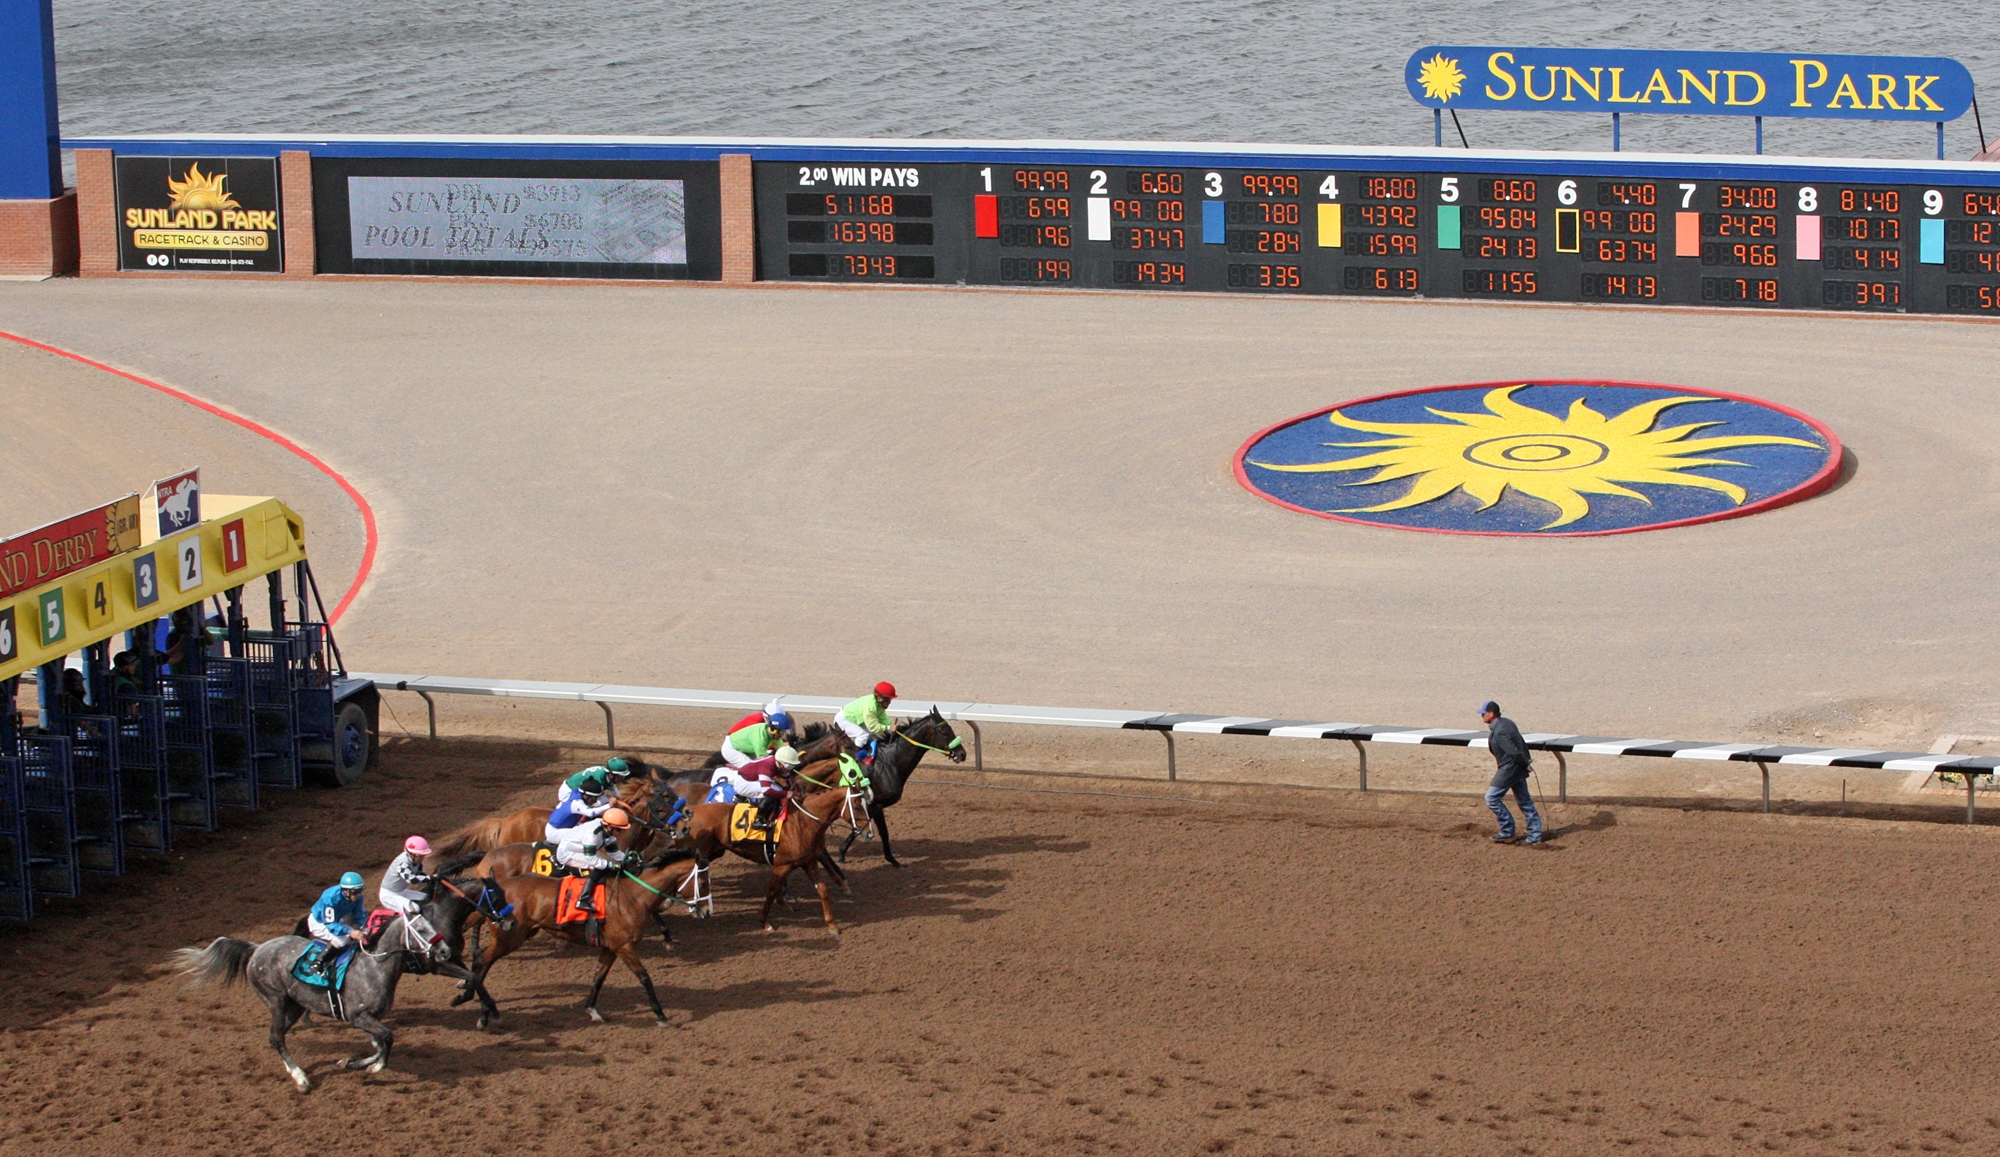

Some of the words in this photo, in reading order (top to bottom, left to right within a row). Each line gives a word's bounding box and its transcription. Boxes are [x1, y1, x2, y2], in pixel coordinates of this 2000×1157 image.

[1485, 52, 1767, 106] SUNLAND
[1790, 59, 1944, 111] PARK
[830, 167, 866, 187] WIN
[872, 167, 920, 188] PAYS
[980, 167, 993, 192] 1
[1015, 170, 1069, 191] 99.99
[1089, 169, 1108, 195] 2
[1141, 172, 1183, 194] 6.60
[1204, 172, 1223, 198] 3
[1243, 174, 1299, 197] 99.99
[1319, 175, 1339, 200] 4
[1367, 177, 1416, 200] 18.80
[1440, 177, 1460, 203] 5
[1493, 180, 1536, 202] 8.60
[1557, 179, 1578, 206] 6
[1612, 183, 1656, 207] 4.40
[1678, 183, 1697, 209] 7
[1721, 186, 1777, 209] 34.00
[1797, 186, 1818, 212] 8
[1840, 189, 1899, 213] 81.40
[387, 191, 521, 214] SUNLAND
[825, 194, 894, 216] 51168
[1028, 197, 1070, 218] 699
[1258, 202, 1299, 225] 780
[1923, 189, 1944, 216] 9
[126, 208, 218, 230] SUNLAND
[221, 210, 278, 230] PARK
[1361, 205, 1417, 227] 4392
[1480, 207, 1537, 230] 9584
[1719, 214, 1777, 237] 2429
[139, 233, 210, 245] RACETRACK
[212, 235, 220, 245] &
[222, 235, 265, 246] CASINO
[363, 225, 436, 248] POOL
[833, 221, 895, 243] 16398
[1036, 226, 1070, 247] 196
[1131, 228, 1184, 249] 3747
[1849, 218, 1899, 240] 1017
[1973, 221, 2000, 244] 12
[1257, 231, 1300, 253] 284
[1369, 233, 1417, 255] 1599
[1480, 236, 1537, 259] 2413
[1599, 239, 1657, 262] 6374
[844, 255, 896, 277] 7343
[1733, 243, 1777, 267] 966
[1855, 249, 1900, 269] 414
[1036, 260, 1071, 281] 199
[1138, 262, 1185, 283] 1934
[1260, 265, 1300, 288] 335
[1375, 268, 1418, 290] 613
[1488, 271, 1537, 294] 1155
[1607, 276, 1657, 298] 1413
[1735, 278, 1777, 301] 718
[1857, 283, 1899, 305] 391
[33, 529, 98, 579] DERBY
[229, 529, 239, 563] 1
[184, 547, 196, 580] 2
[139, 563, 152, 598] 3
[94, 581, 107, 616] 4
[46, 600, 60, 639] 5
[0, 618, 12, 655] 6
[735, 809, 751, 834] 4
[532, 848, 553, 876] 6
[324, 906, 335, 923] 9
